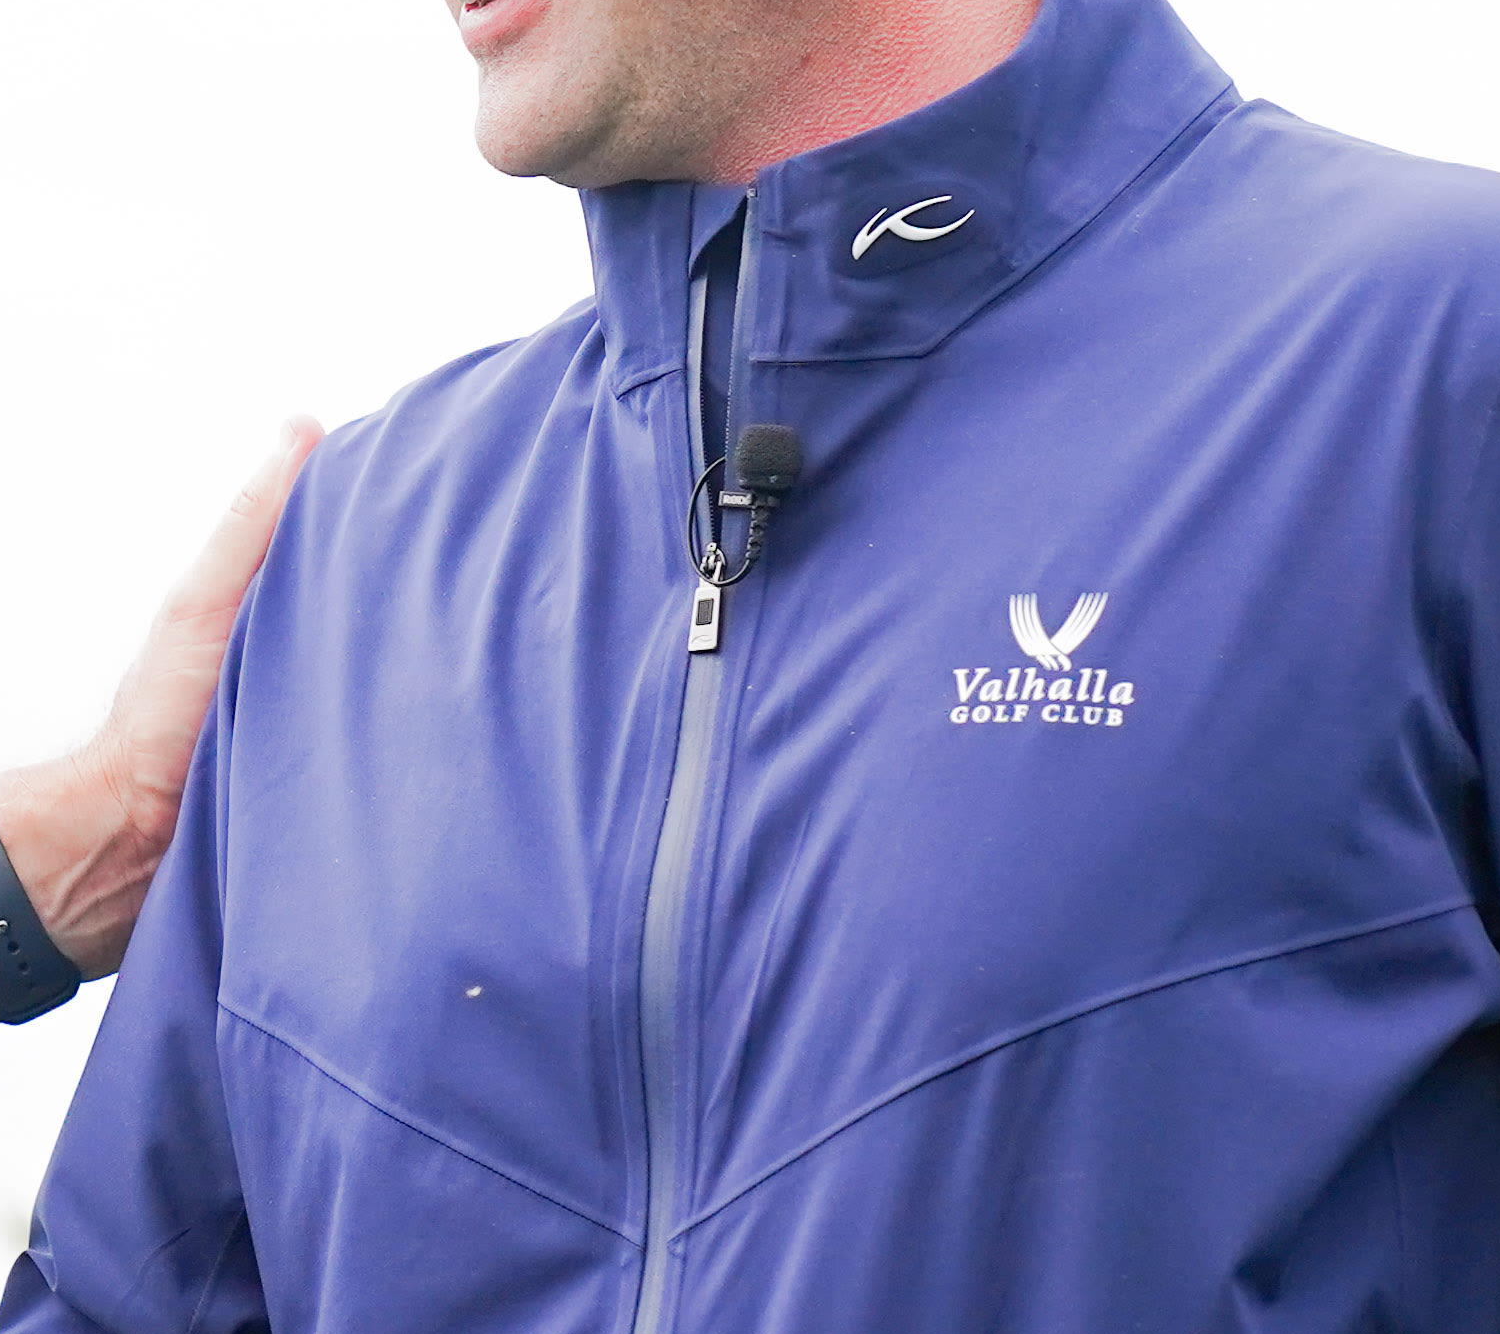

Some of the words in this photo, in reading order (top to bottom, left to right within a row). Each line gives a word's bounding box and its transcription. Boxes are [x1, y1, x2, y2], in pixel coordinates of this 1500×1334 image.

[952, 666, 1136, 705] Valhalla
[950, 703, 1030, 724] GOLF
[1040, 703, 1125, 727] CLUB
